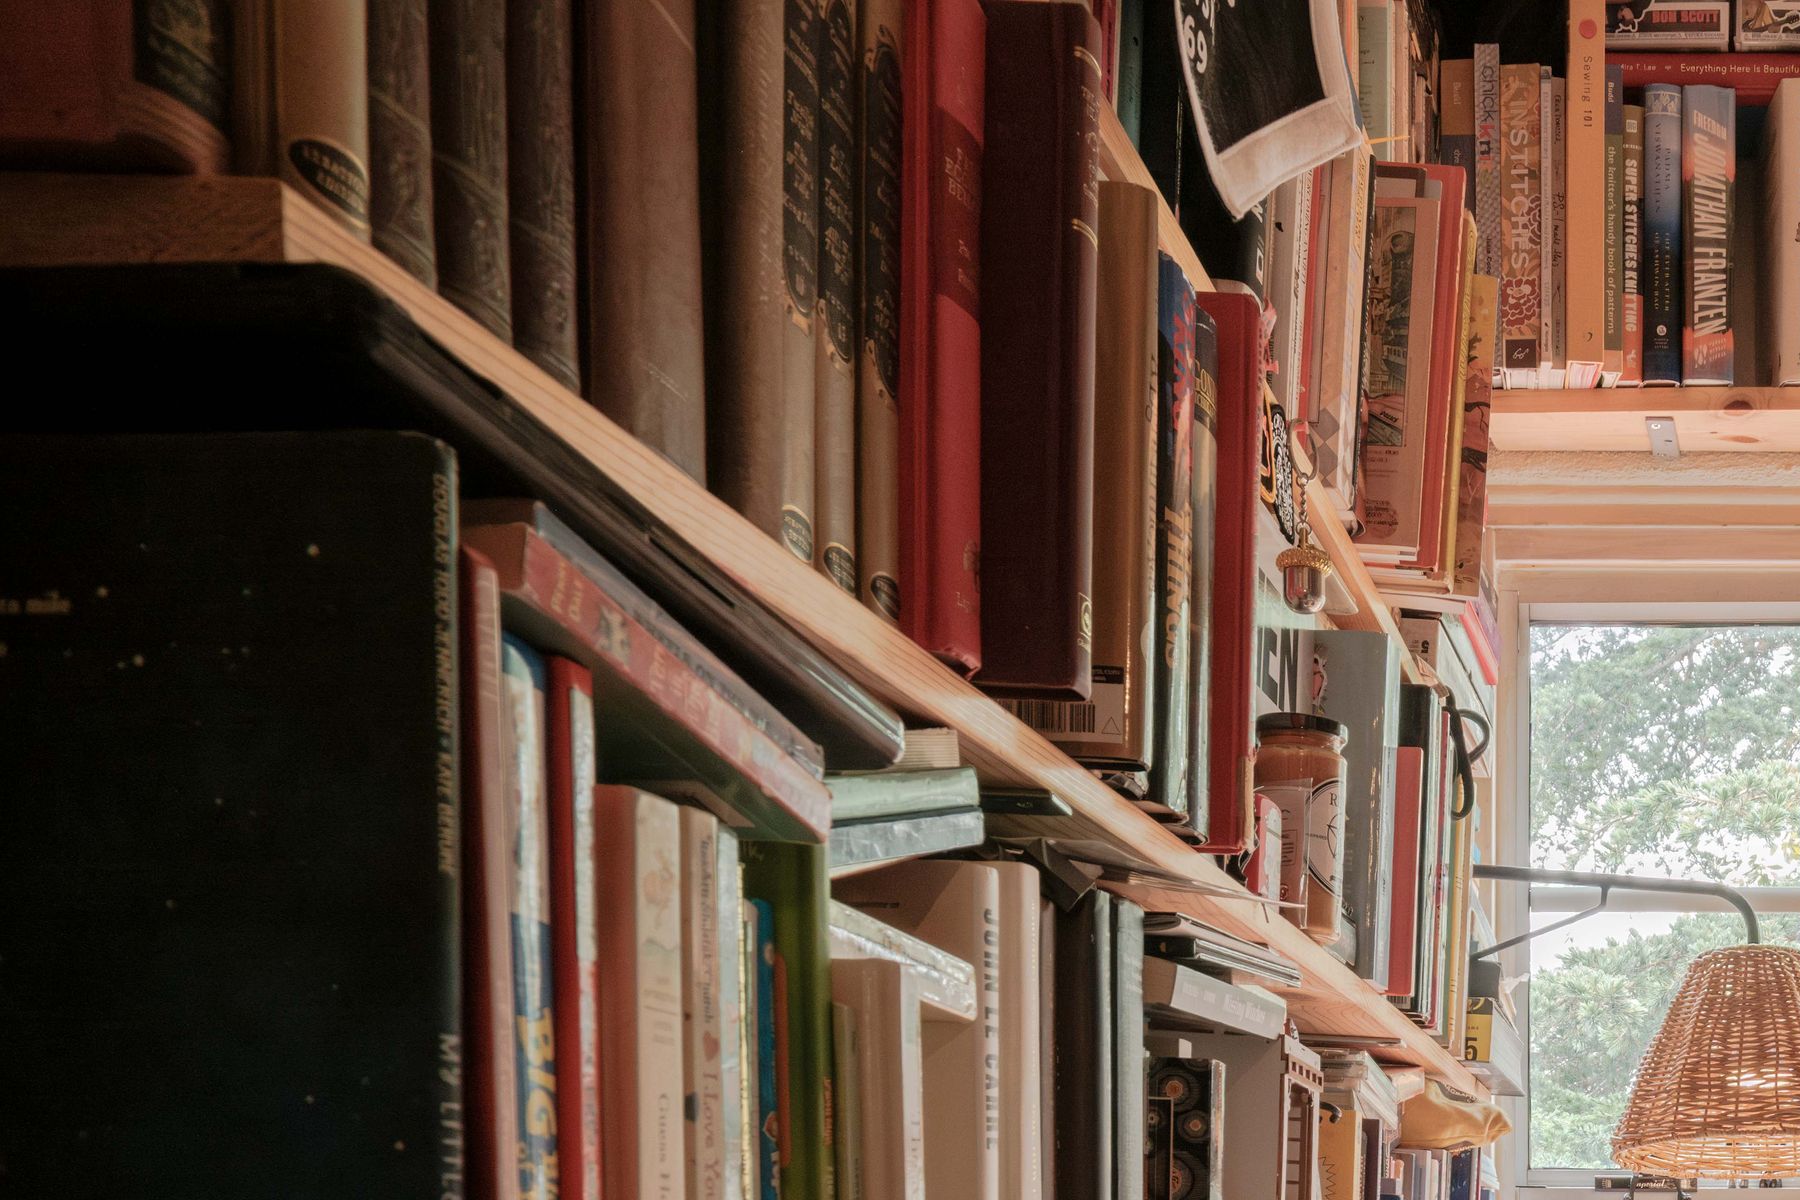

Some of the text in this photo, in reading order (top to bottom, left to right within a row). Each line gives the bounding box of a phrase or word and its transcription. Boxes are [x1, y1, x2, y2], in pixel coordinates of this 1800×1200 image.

[1582, 56, 1592, 128] Sewing 101
[1680, 64, 1727, 75] Everything
[1730, 64, 1750, 73] Here
[1753, 64, 1761, 73] Is
[1624, 158, 1638, 332] SUPER STITCHES KNITTING
[1694, 132, 1726, 338] JONATHAN FRANZEN
[703, 1090, 718, 1148] Love
